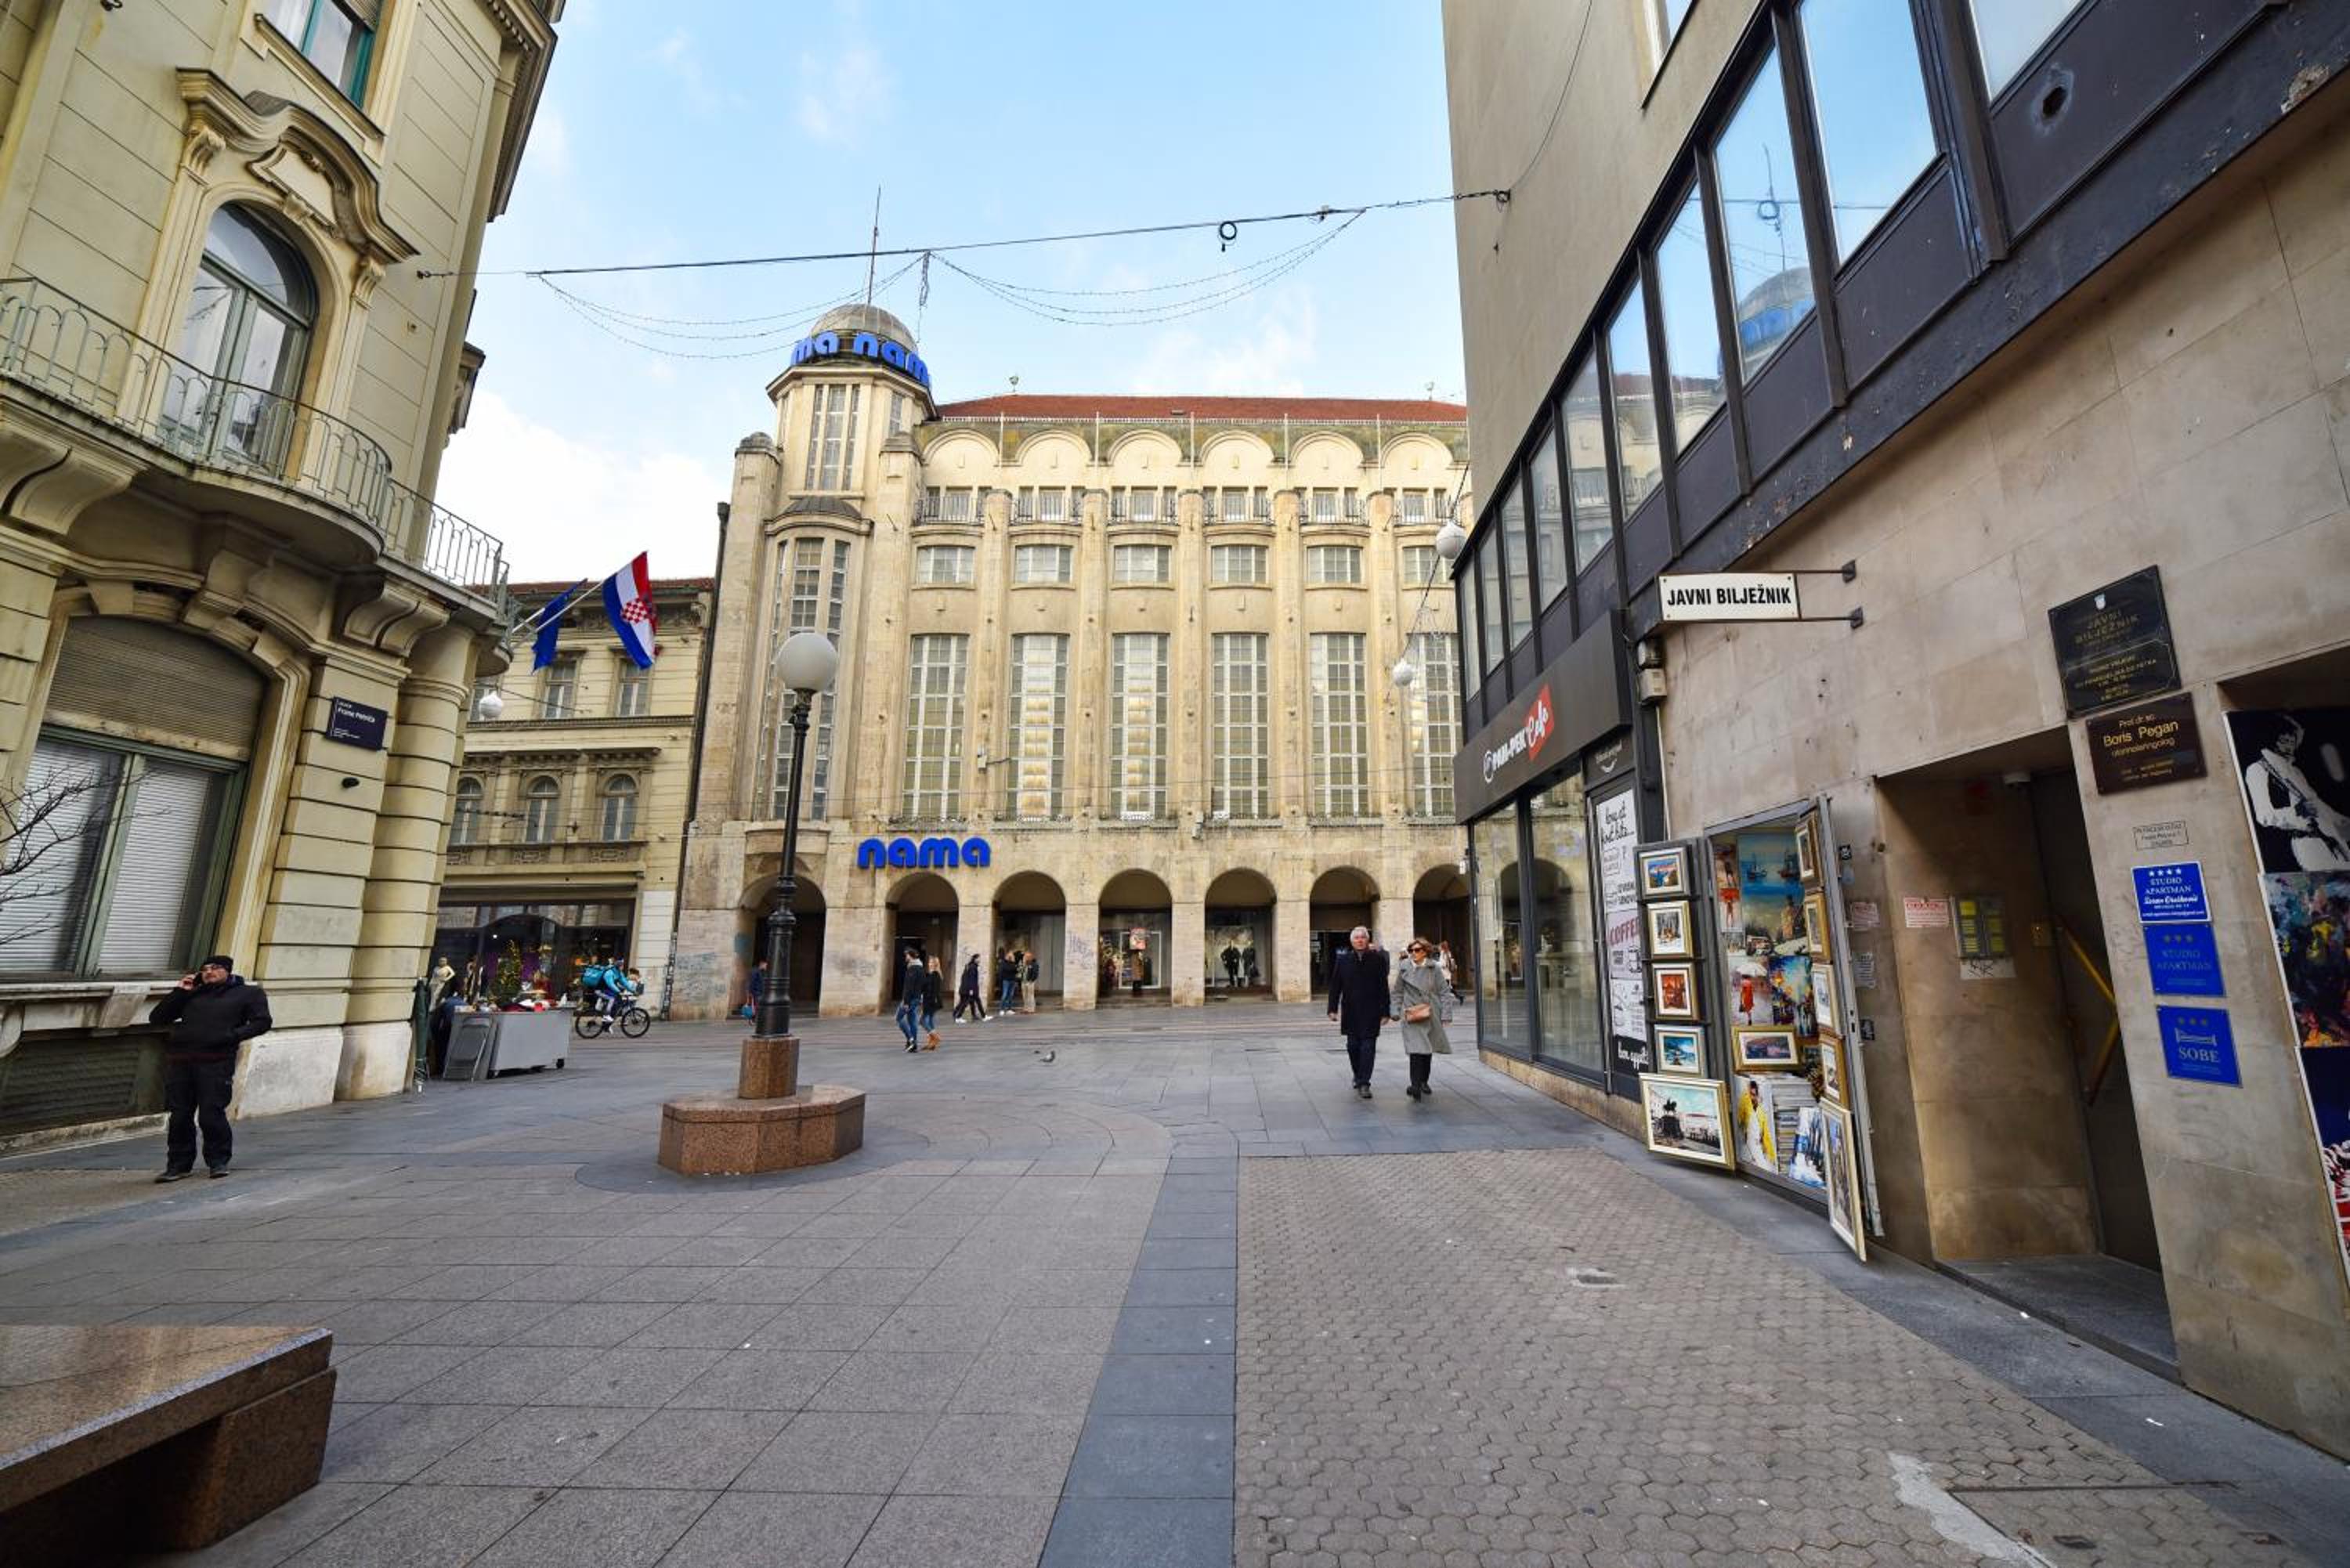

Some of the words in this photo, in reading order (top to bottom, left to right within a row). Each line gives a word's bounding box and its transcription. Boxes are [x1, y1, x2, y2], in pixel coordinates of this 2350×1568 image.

[791, 331, 839, 366] ma
[852, 332, 930, 389] nam
[1668, 589, 1711, 605] JAVNI
[1716, 583, 1791, 604] BILJEŽNIK
[2104, 732, 2132, 747] Boris
[2138, 721, 2178, 739] Pegan
[858, 838, 990, 869] nama
[2145, 886, 2193, 897] APARTMAN
[2150, 876, 2183, 887] STUDIO
[2160, 948, 2201, 959] STUDIO
[2178, 1046, 2221, 1064] SOBE
